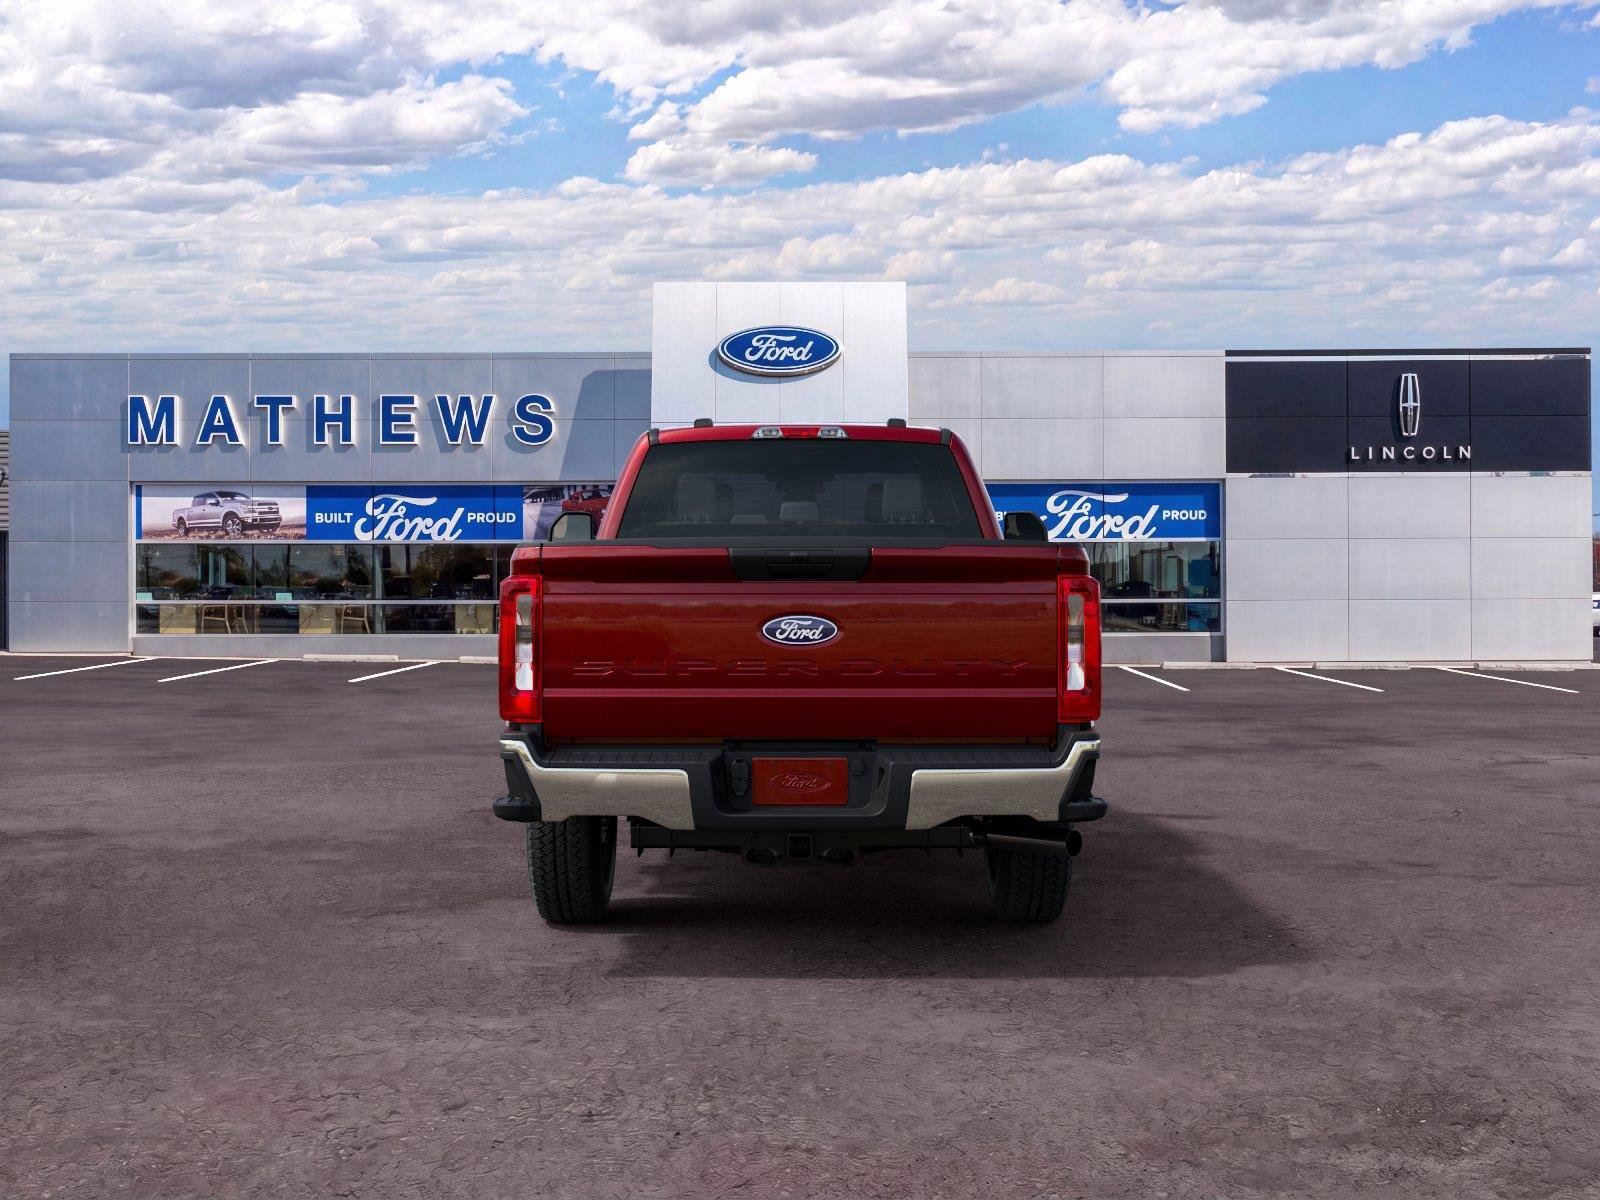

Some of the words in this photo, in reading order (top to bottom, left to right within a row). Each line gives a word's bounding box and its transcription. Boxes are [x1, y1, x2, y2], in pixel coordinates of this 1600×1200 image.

[745, 334, 813, 360] Ford
[127, 394, 555, 445] MATHEWS
[1351, 446, 1471, 459] LINCOLN
[315, 512, 353, 523] BUILT
[354, 494, 465, 541] Ford
[467, 512, 516, 523] PROUD
[1041, 490, 1159, 538] Ford
[1162, 509, 1207, 520] PROUD
[776, 620, 824, 639] Ford
[572, 658, 820, 676] SUPER
[840, 658, 1029, 676] DUTY
[781, 775, 818, 788] Ford
